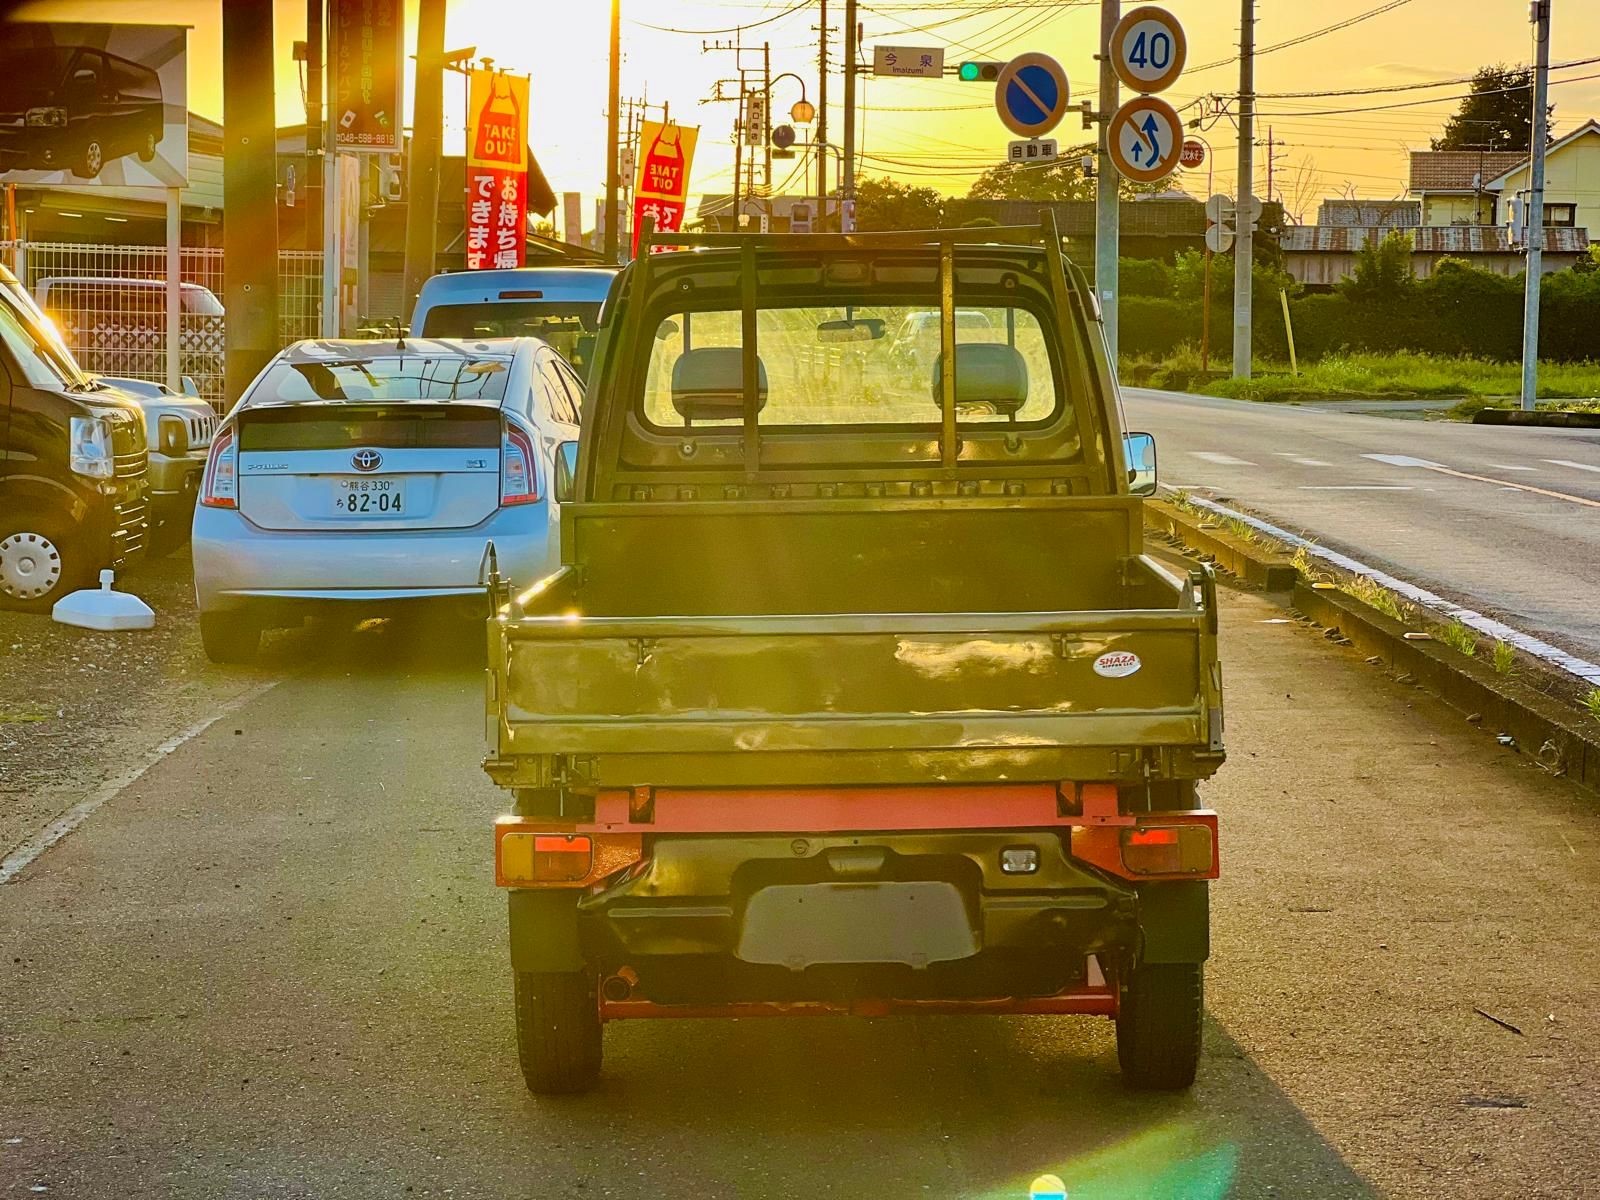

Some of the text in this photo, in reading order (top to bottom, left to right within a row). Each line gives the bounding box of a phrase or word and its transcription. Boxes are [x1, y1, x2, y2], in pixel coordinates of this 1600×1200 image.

[1128, 31, 1170, 69] 40
[884, 52, 933, 67] 今泉
[892, 66, 924, 74] Imaizumi
[484, 123, 516, 140] TAKE
[484, 139, 513, 156] OUT
[1012, 144, 1053, 158] 自動車
[349, 481, 390, 491] 熊谷 330
[336, 493, 401, 512] ち 82-04
[1099, 655, 1136, 665] SHAZA
